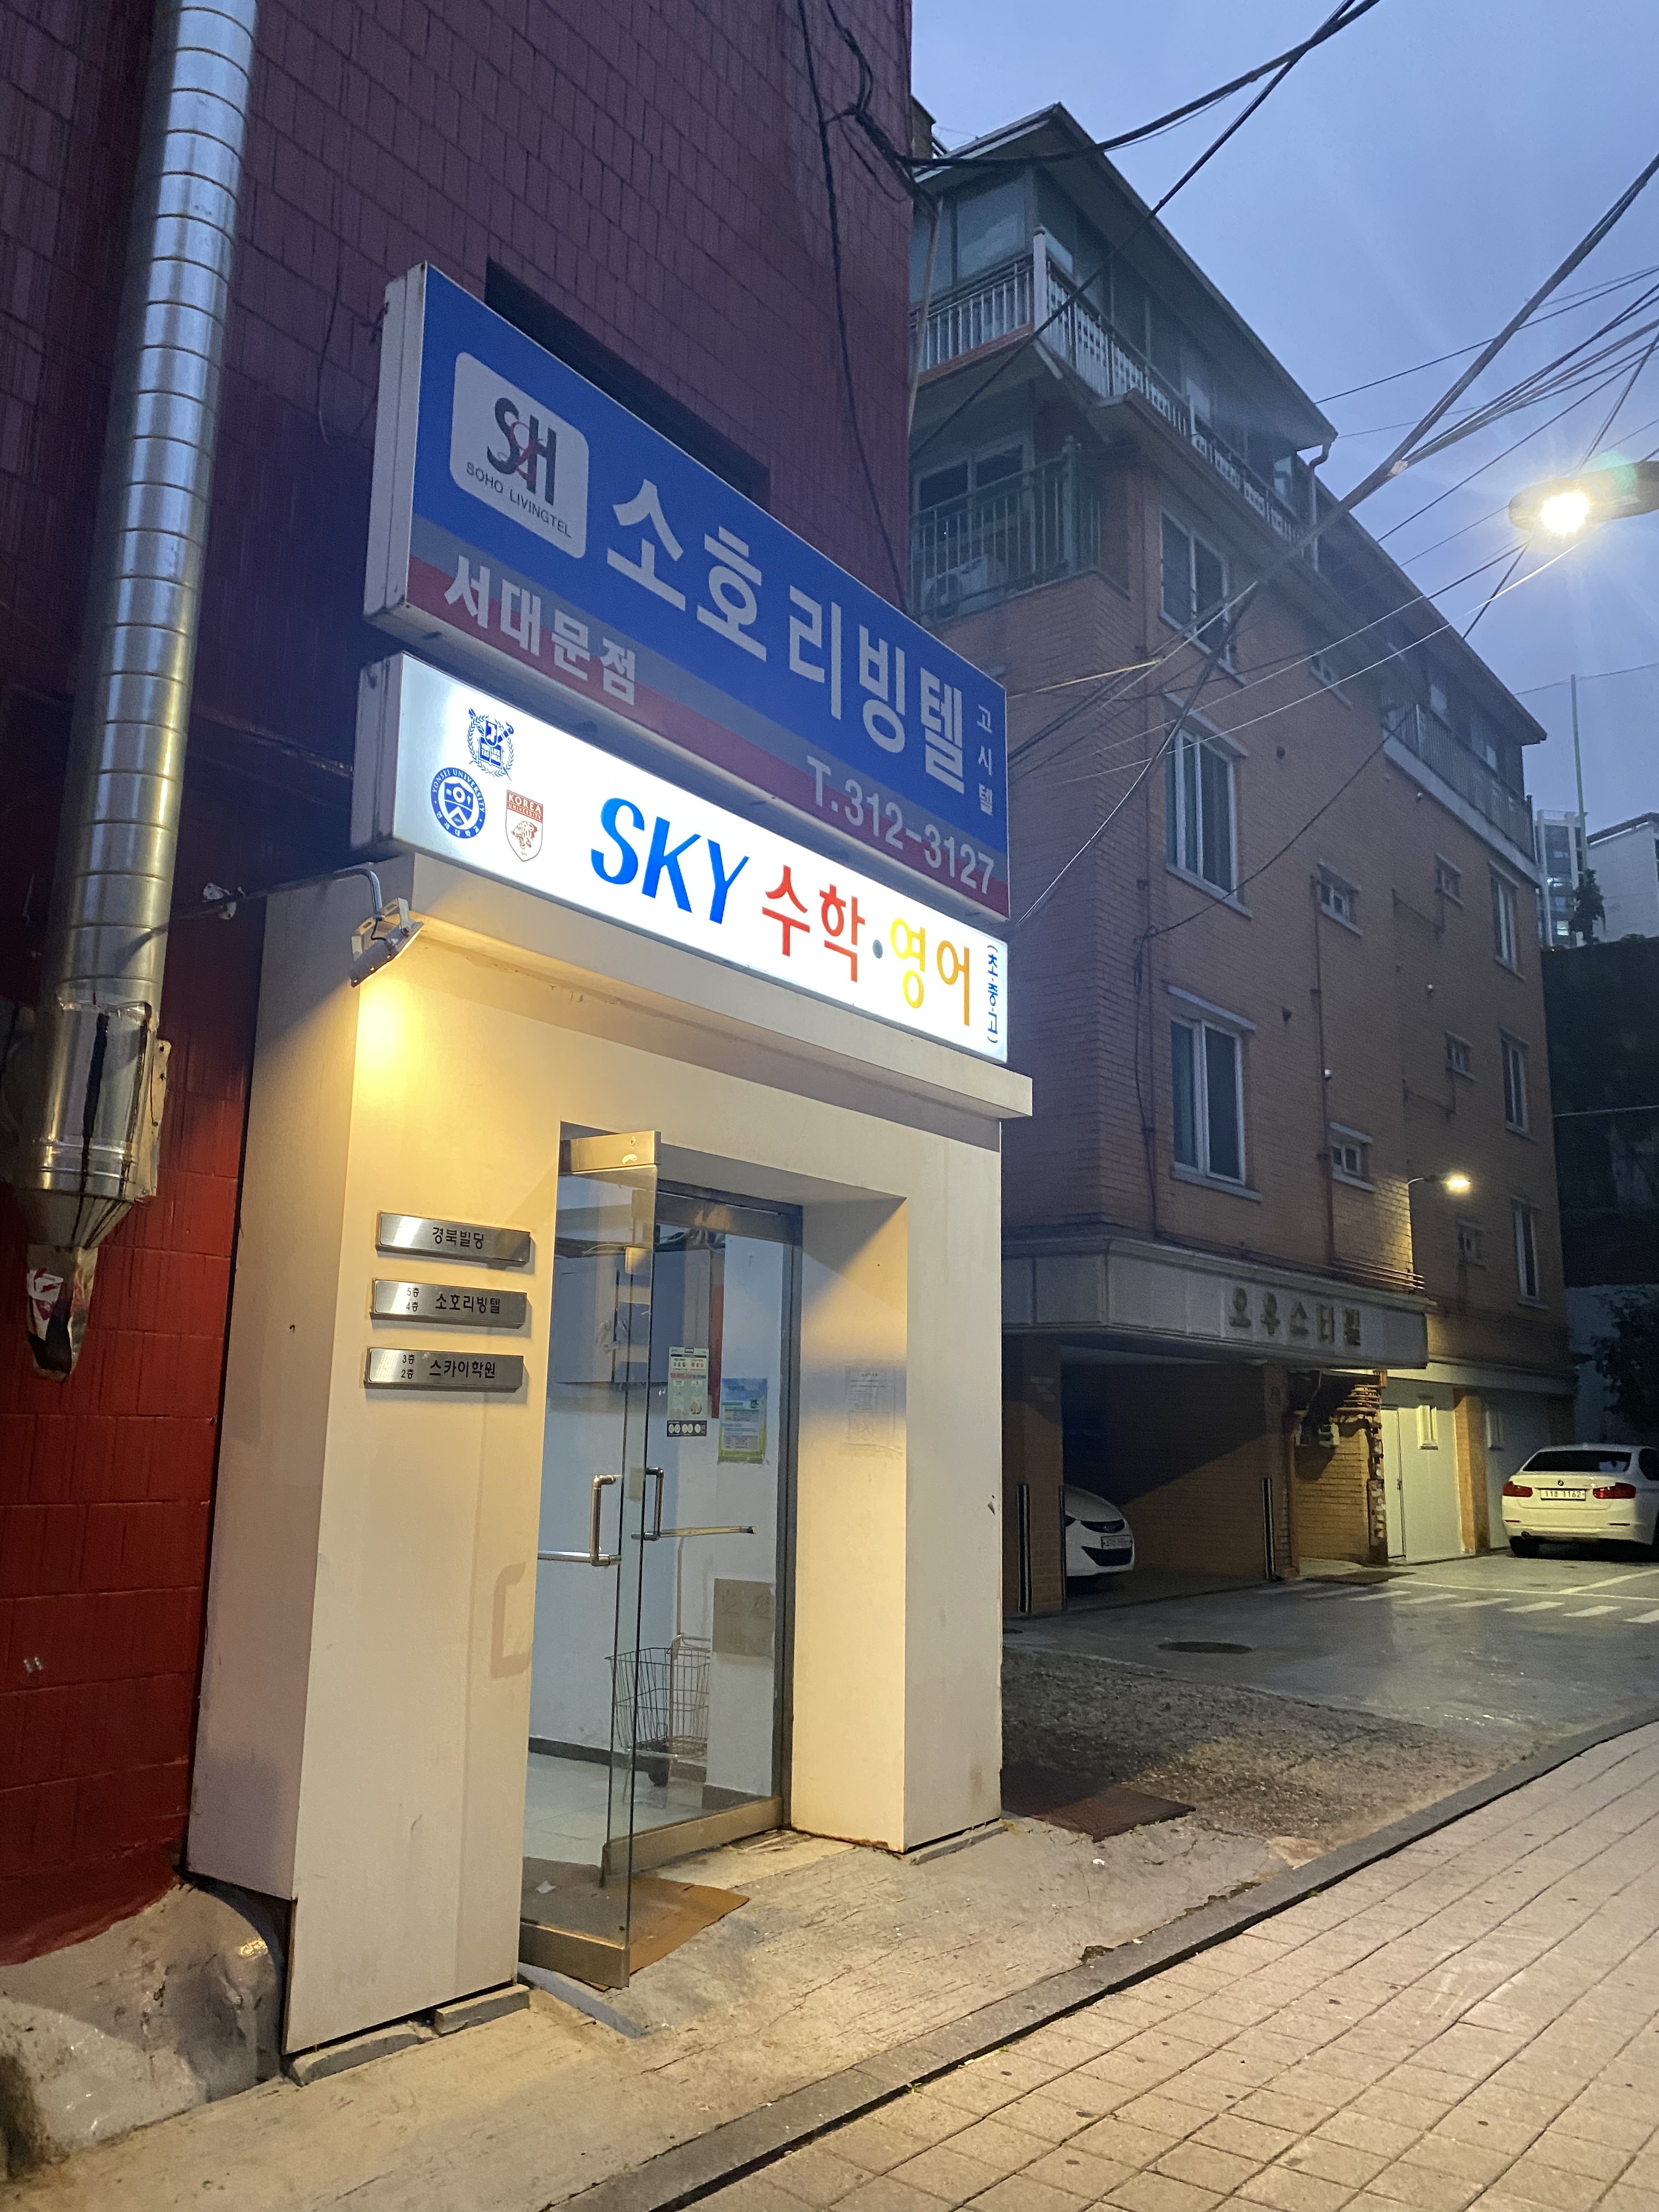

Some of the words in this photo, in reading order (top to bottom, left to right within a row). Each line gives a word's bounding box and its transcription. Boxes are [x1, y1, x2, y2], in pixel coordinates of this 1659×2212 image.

[466, 462, 503, 493] SOHO
[510, 489, 572, 538] LIVINGTEL
[444, 555, 635, 705] 서대문점
[432, 769, 450, 793] YONSEI
[453, 769, 485, 813] UNIVERSITY
[509, 793, 541, 814] KOREA
[509, 803, 541, 820] UNIVERSITY
[808, 755, 994, 894] T.312-3127
[590, 797, 749, 925] SKY
[432, 1227, 484, 1249] 경북빌딩
[407, 1288, 419, 1297] 5층
[406, 1301, 419, 1312] 4층
[435, 1294, 500, 1314] 소호리빙텔
[402, 1354, 415, 1364] 3층
[401, 1369, 414, 1379] 2층
[430, 1360, 495, 1379] 스카이학원
